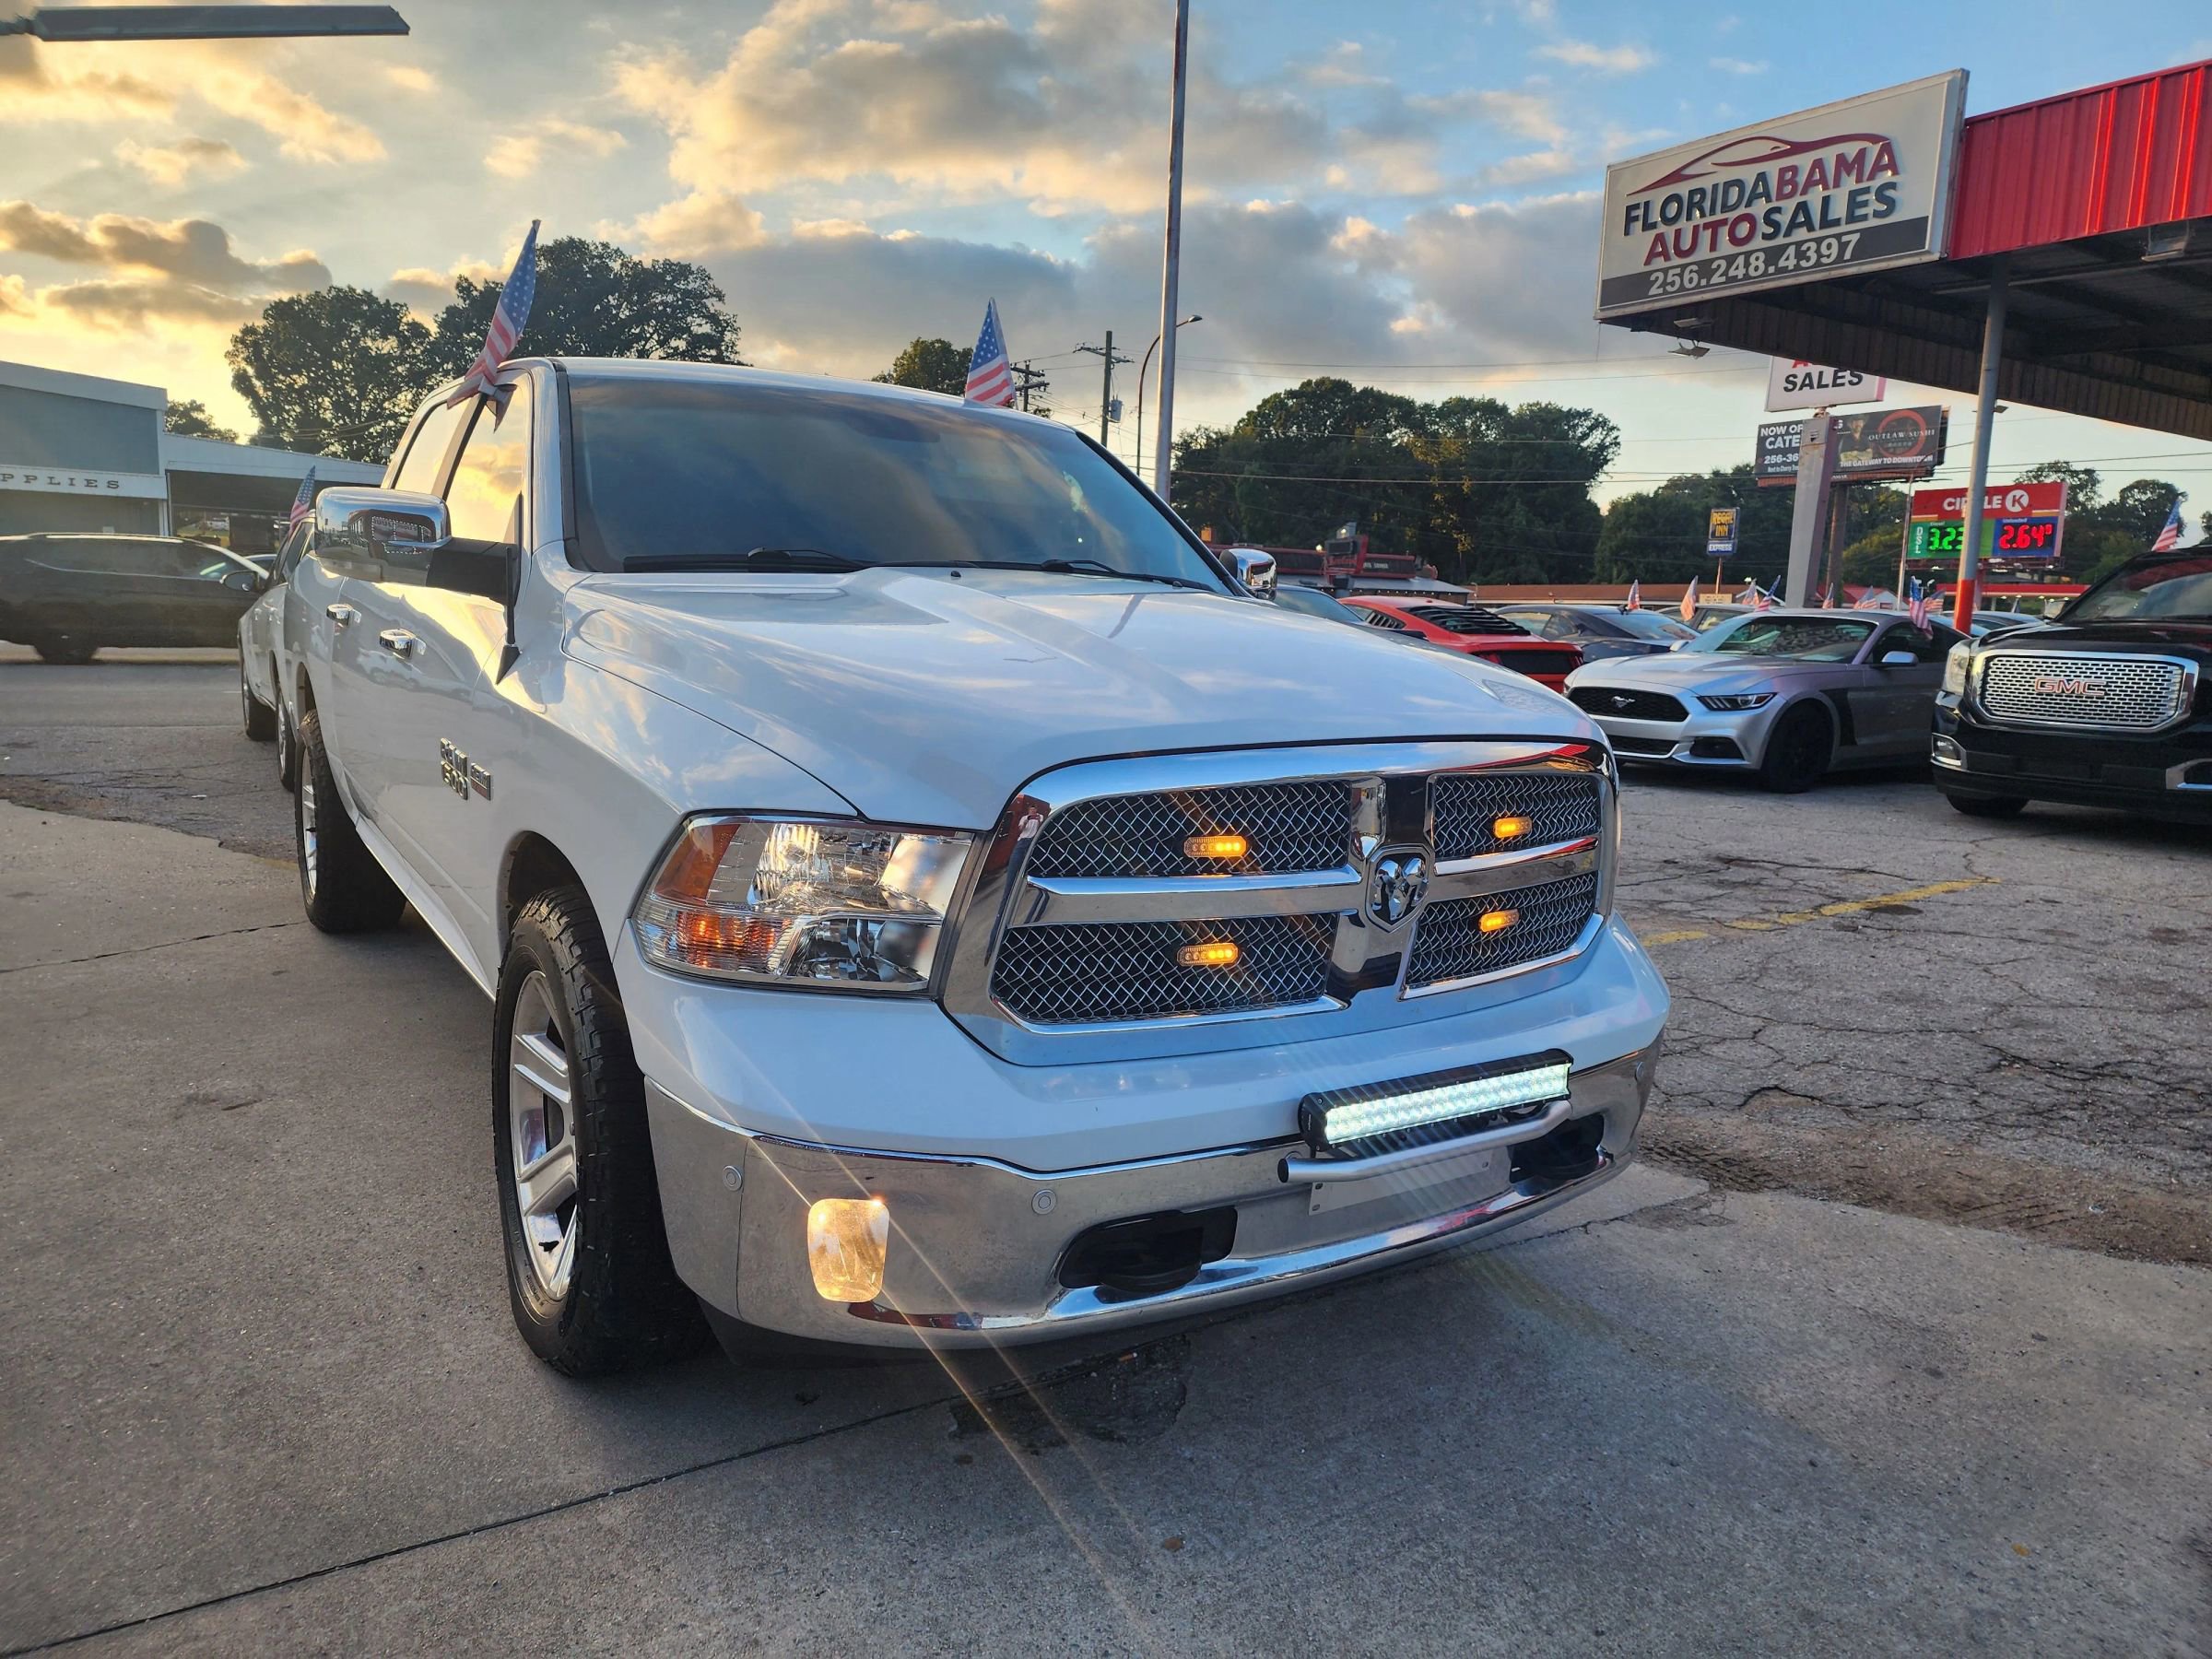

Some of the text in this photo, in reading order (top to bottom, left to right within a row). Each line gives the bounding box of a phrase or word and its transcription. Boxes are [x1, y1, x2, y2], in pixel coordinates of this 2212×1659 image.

[1624, 140, 1900, 236] FLORIDABAMA
[1648, 232, 1861, 296] 256.248.4397
[1783, 370, 1864, 393] SALES
[1761, 426, 1787, 437] NOW
[1868, 429, 1935, 441] OUTLAW SUSHI
[1853, 458, 1882, 466] GATEWAY
[1943, 495, 2002, 511] CILE
[2034, 677, 2107, 697] GMC
